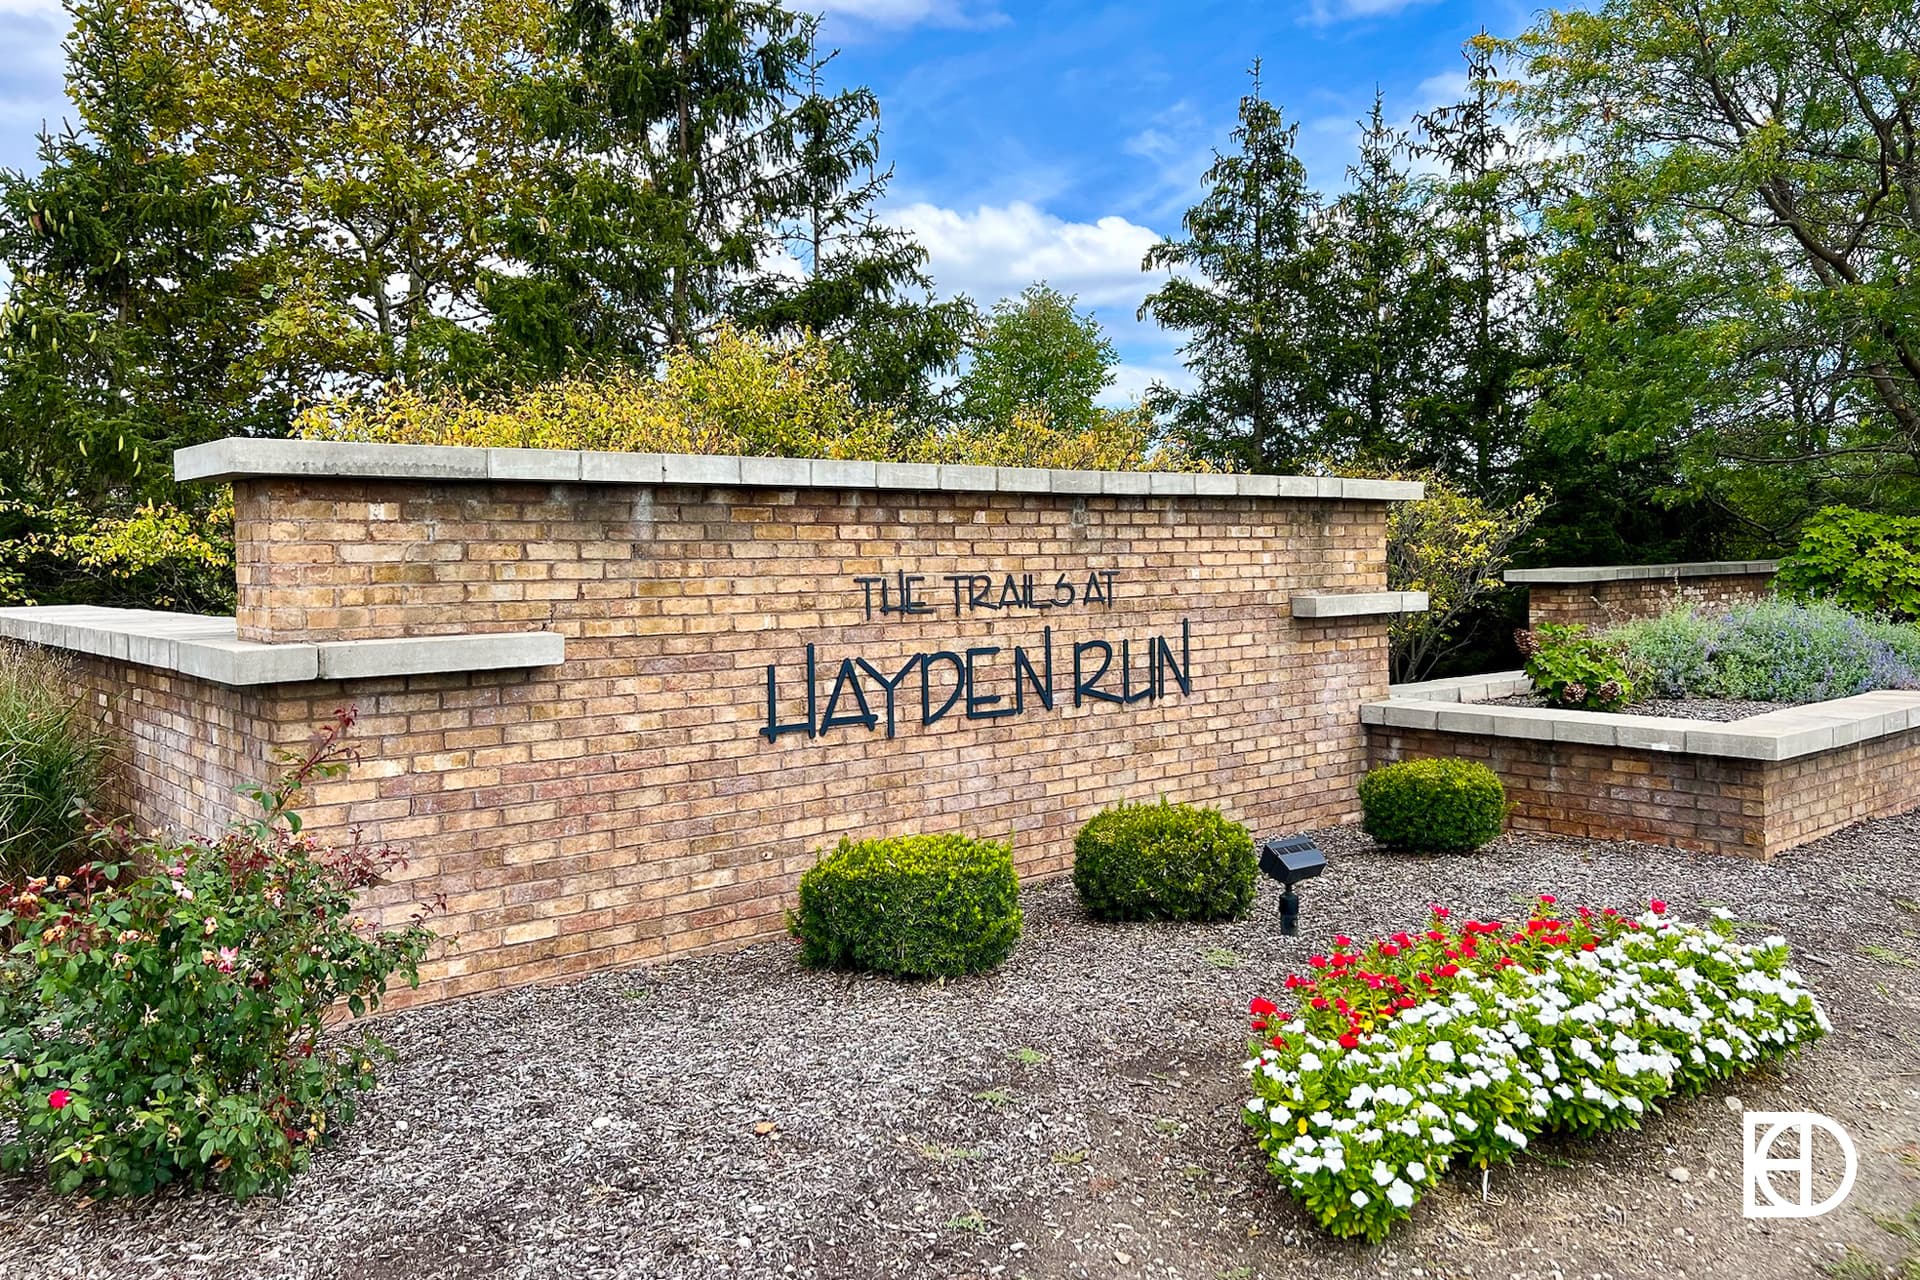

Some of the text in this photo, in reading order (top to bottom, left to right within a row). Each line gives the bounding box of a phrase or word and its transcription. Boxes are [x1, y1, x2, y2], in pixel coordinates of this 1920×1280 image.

[853, 569, 1120, 620] THE TRAILS AT
[759, 618, 1190, 744] HAYDEN RUN
